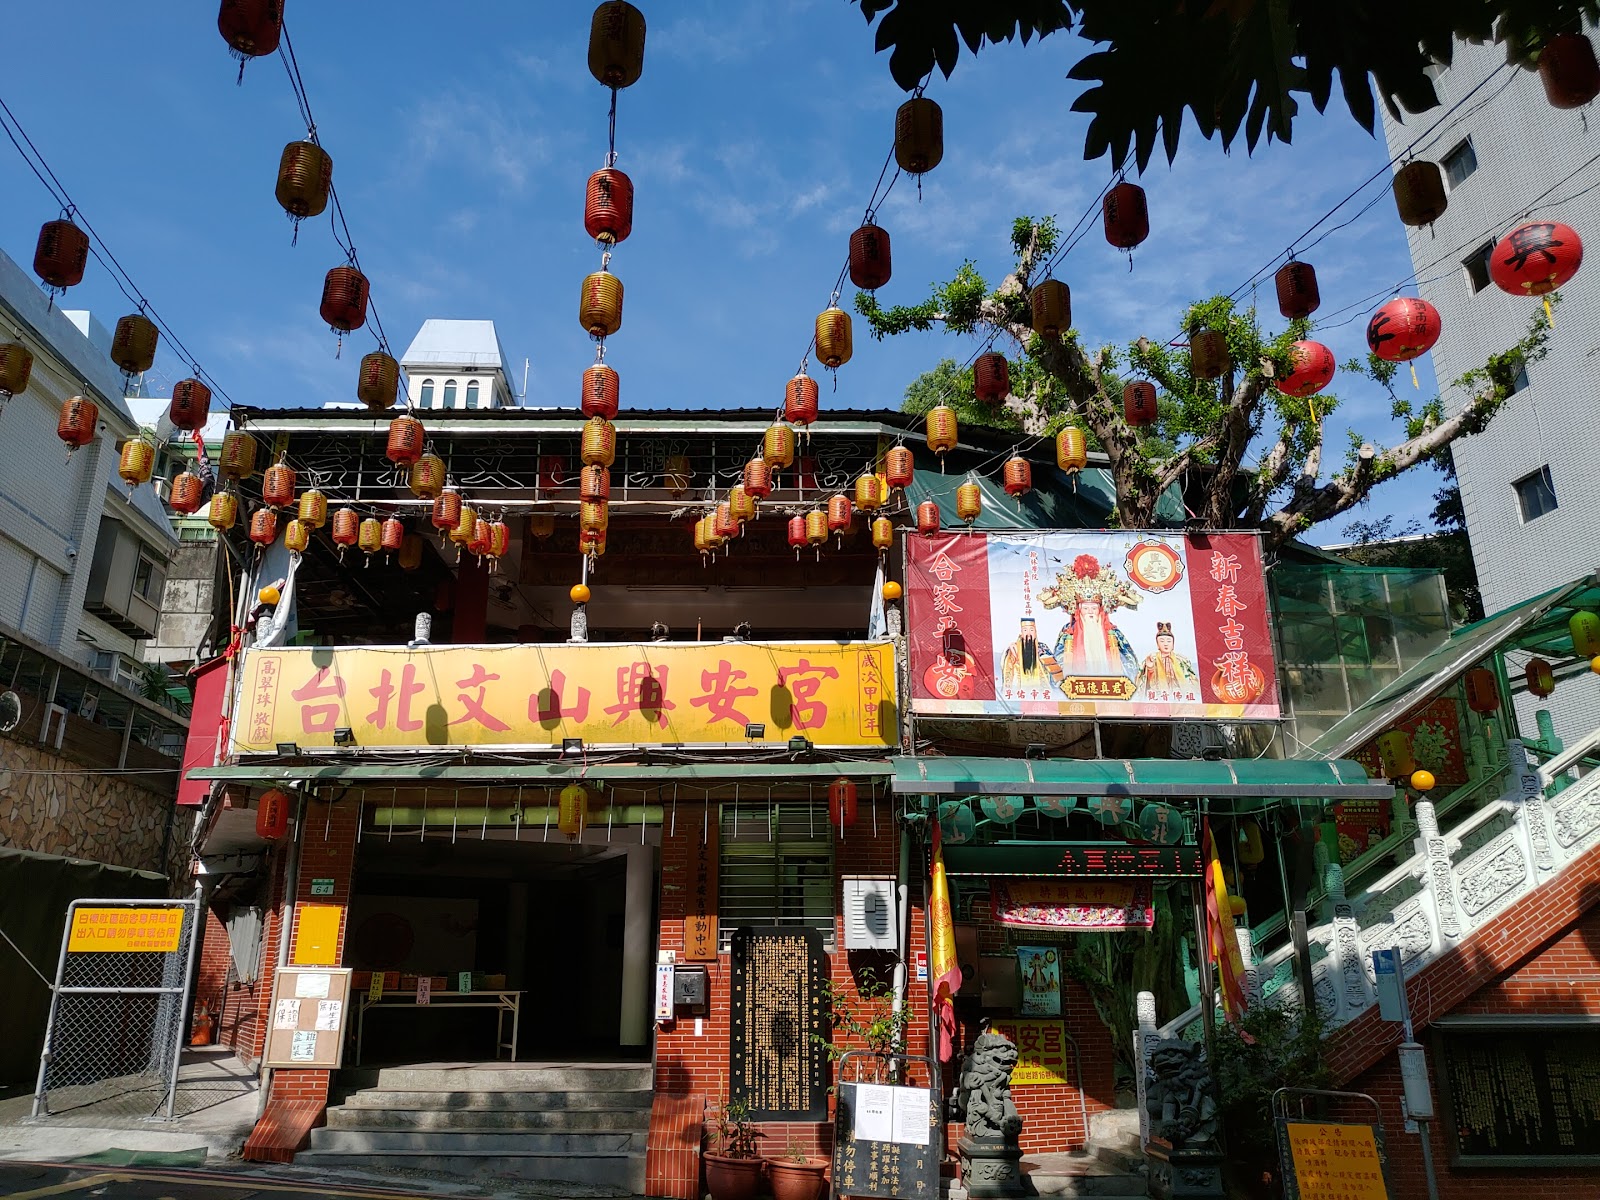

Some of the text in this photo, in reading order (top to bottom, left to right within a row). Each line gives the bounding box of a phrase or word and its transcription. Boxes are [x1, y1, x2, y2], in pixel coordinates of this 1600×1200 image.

[928, 552, 968, 682] 合家平安
[1209, 550, 1252, 684] 新春吉祥
[291, 658, 841, 735] 台北文山興安宮
[861, 654, 880, 734] 歲次甲申年
[1074, 681, 1123, 695] 福德真君
[316, 886, 329, 894] 64
[843, 1129, 856, 1189] 請勿停車
[916, 1160, 923, 1170] 月
